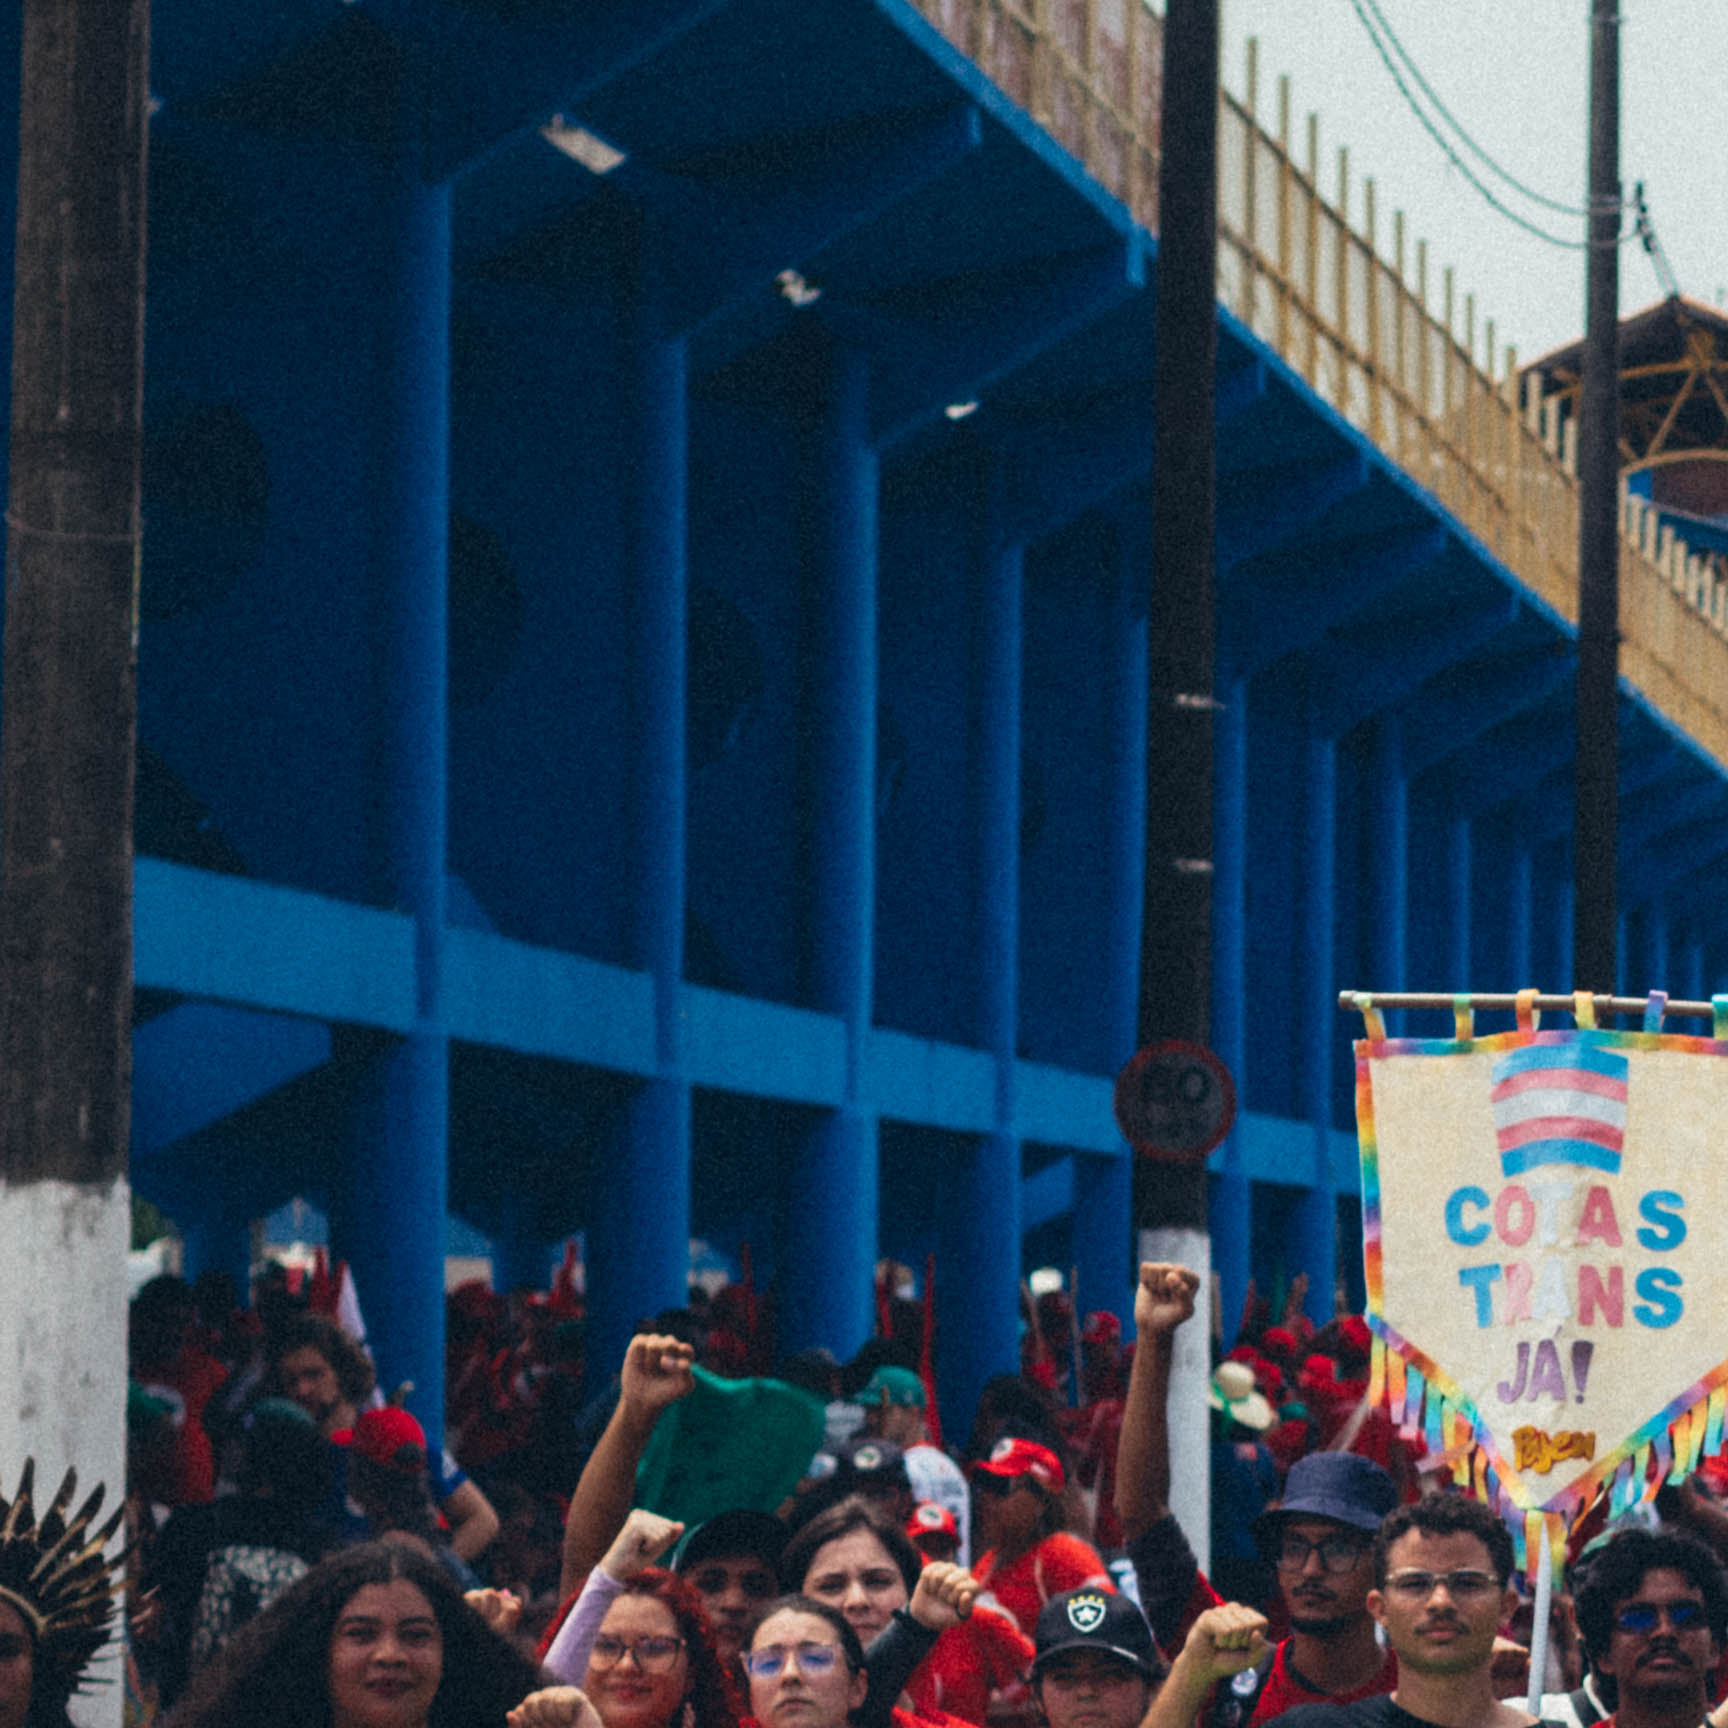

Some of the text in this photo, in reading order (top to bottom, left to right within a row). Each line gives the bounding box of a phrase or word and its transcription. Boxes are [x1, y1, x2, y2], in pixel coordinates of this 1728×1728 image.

[1444, 1182, 1688, 1252] COTAS
[1458, 1254, 1685, 1330] TRANS
[1496, 1325, 1595, 1405] JÁ!
